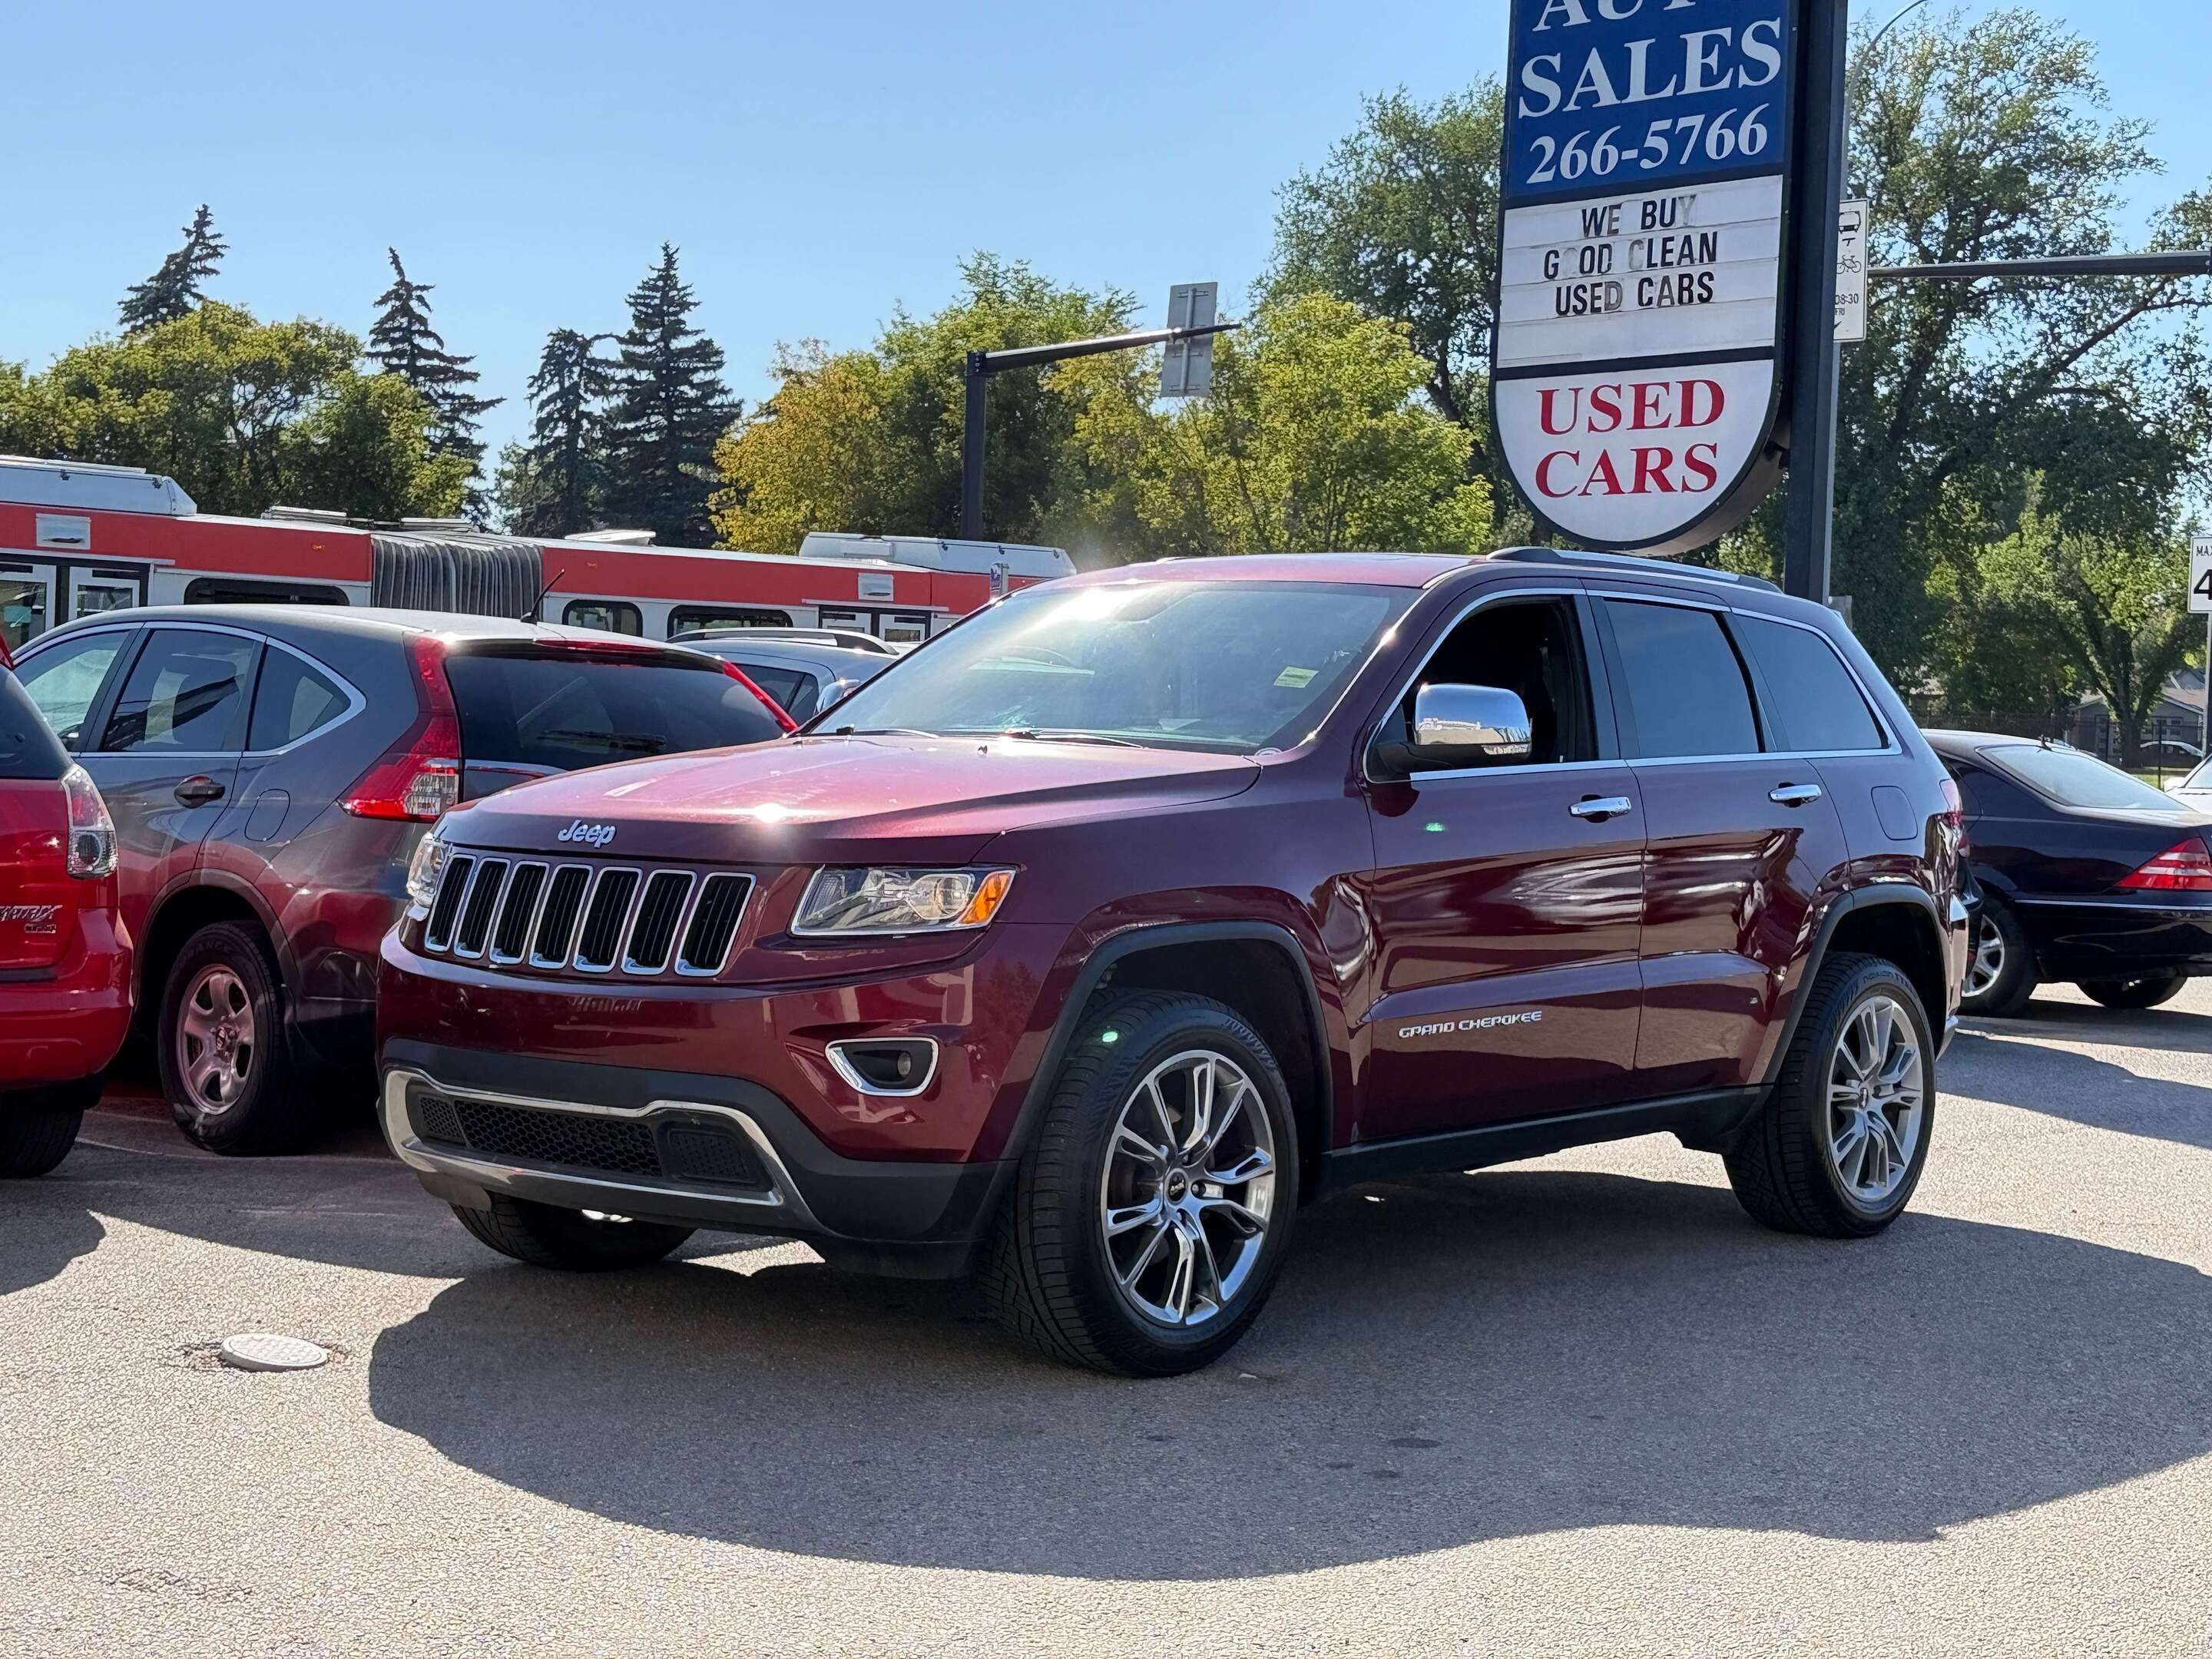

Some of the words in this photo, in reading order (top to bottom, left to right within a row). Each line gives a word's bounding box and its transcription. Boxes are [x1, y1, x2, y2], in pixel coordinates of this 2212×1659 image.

[1518, 17, 1781, 118] SALES
[1525, 103, 1770, 184] 266-5766
[1581, 204, 1622, 237] WE
[1641, 194, 1697, 230] BUY
[1544, 243, 1612, 280] GOD
[1628, 231, 1717, 270] CLEAN
[1555, 281, 1623, 316] USED
[1637, 271, 1714, 307] CARS
[1535, 379, 1725, 435] USED
[1535, 442, 1718, 498] CARS
[2197, 545, 2212, 556] MA
[558, 820, 616, 849] Jeep
[1399, 1022, 1455, 1038] GRAND
[1459, 1011, 1543, 1031] CHEROKEE
